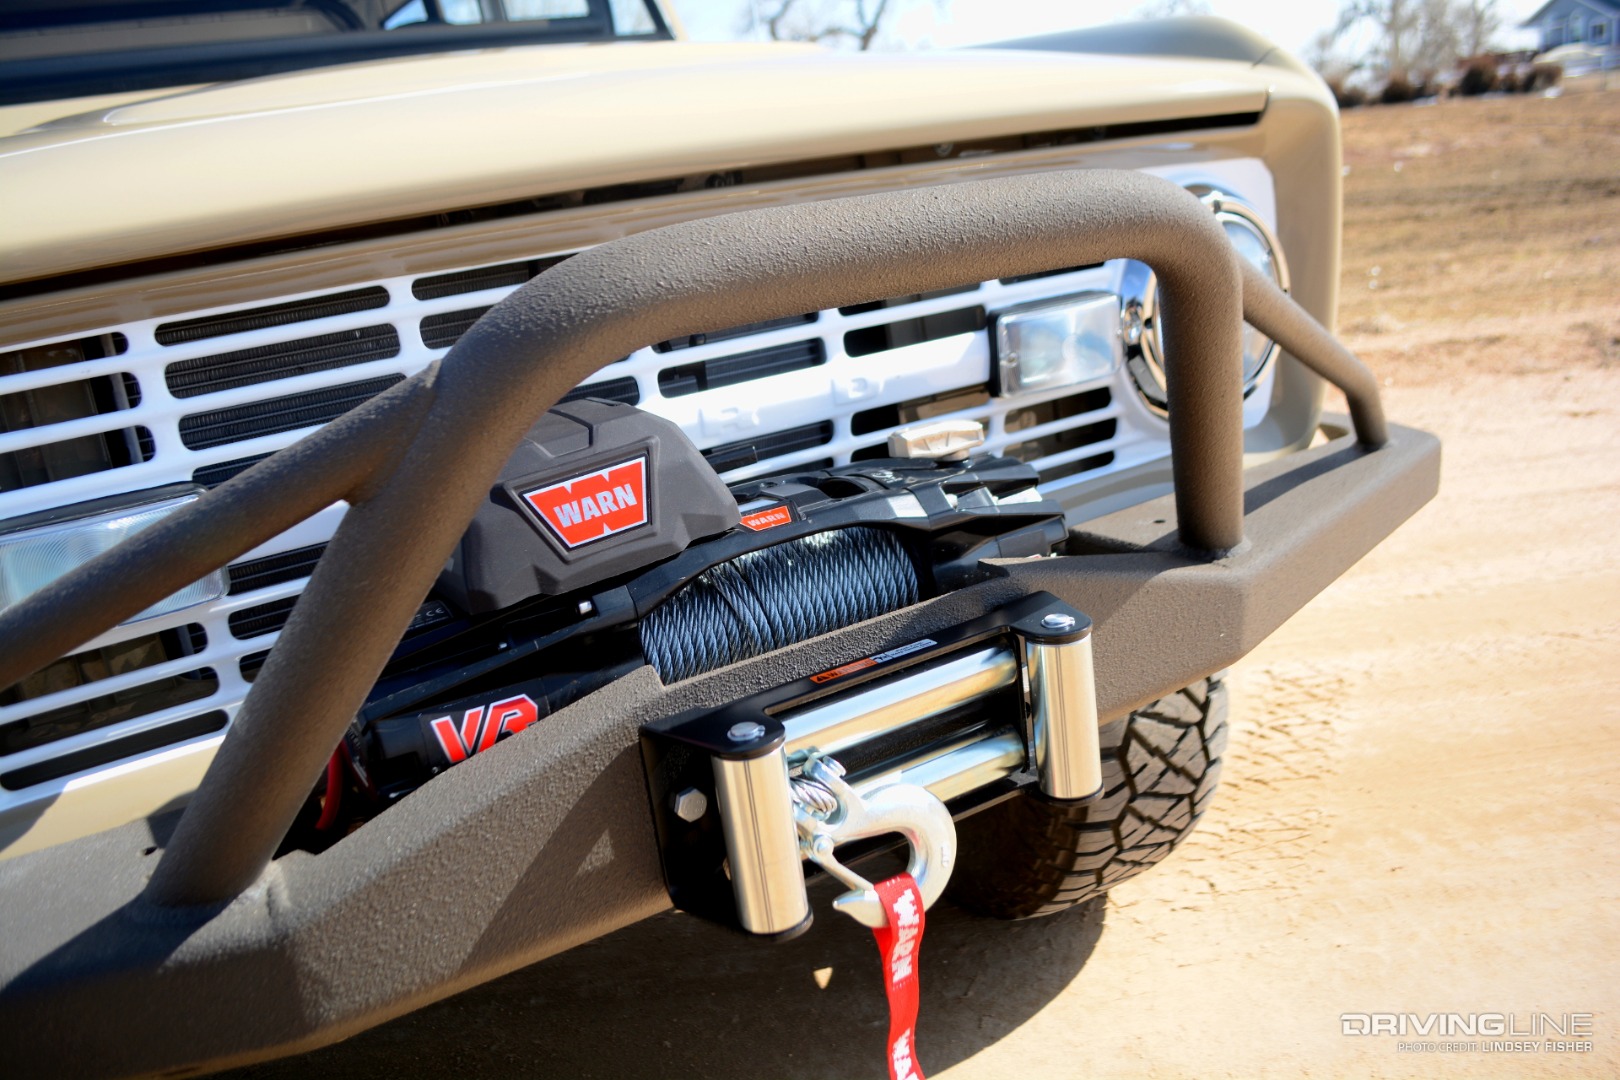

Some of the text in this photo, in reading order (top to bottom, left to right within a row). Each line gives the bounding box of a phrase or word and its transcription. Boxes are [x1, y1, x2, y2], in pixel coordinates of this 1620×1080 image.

[553, 483, 638, 528] WARN
[746, 512, 786, 528] WARN
[892, 888, 919, 984] WARN
